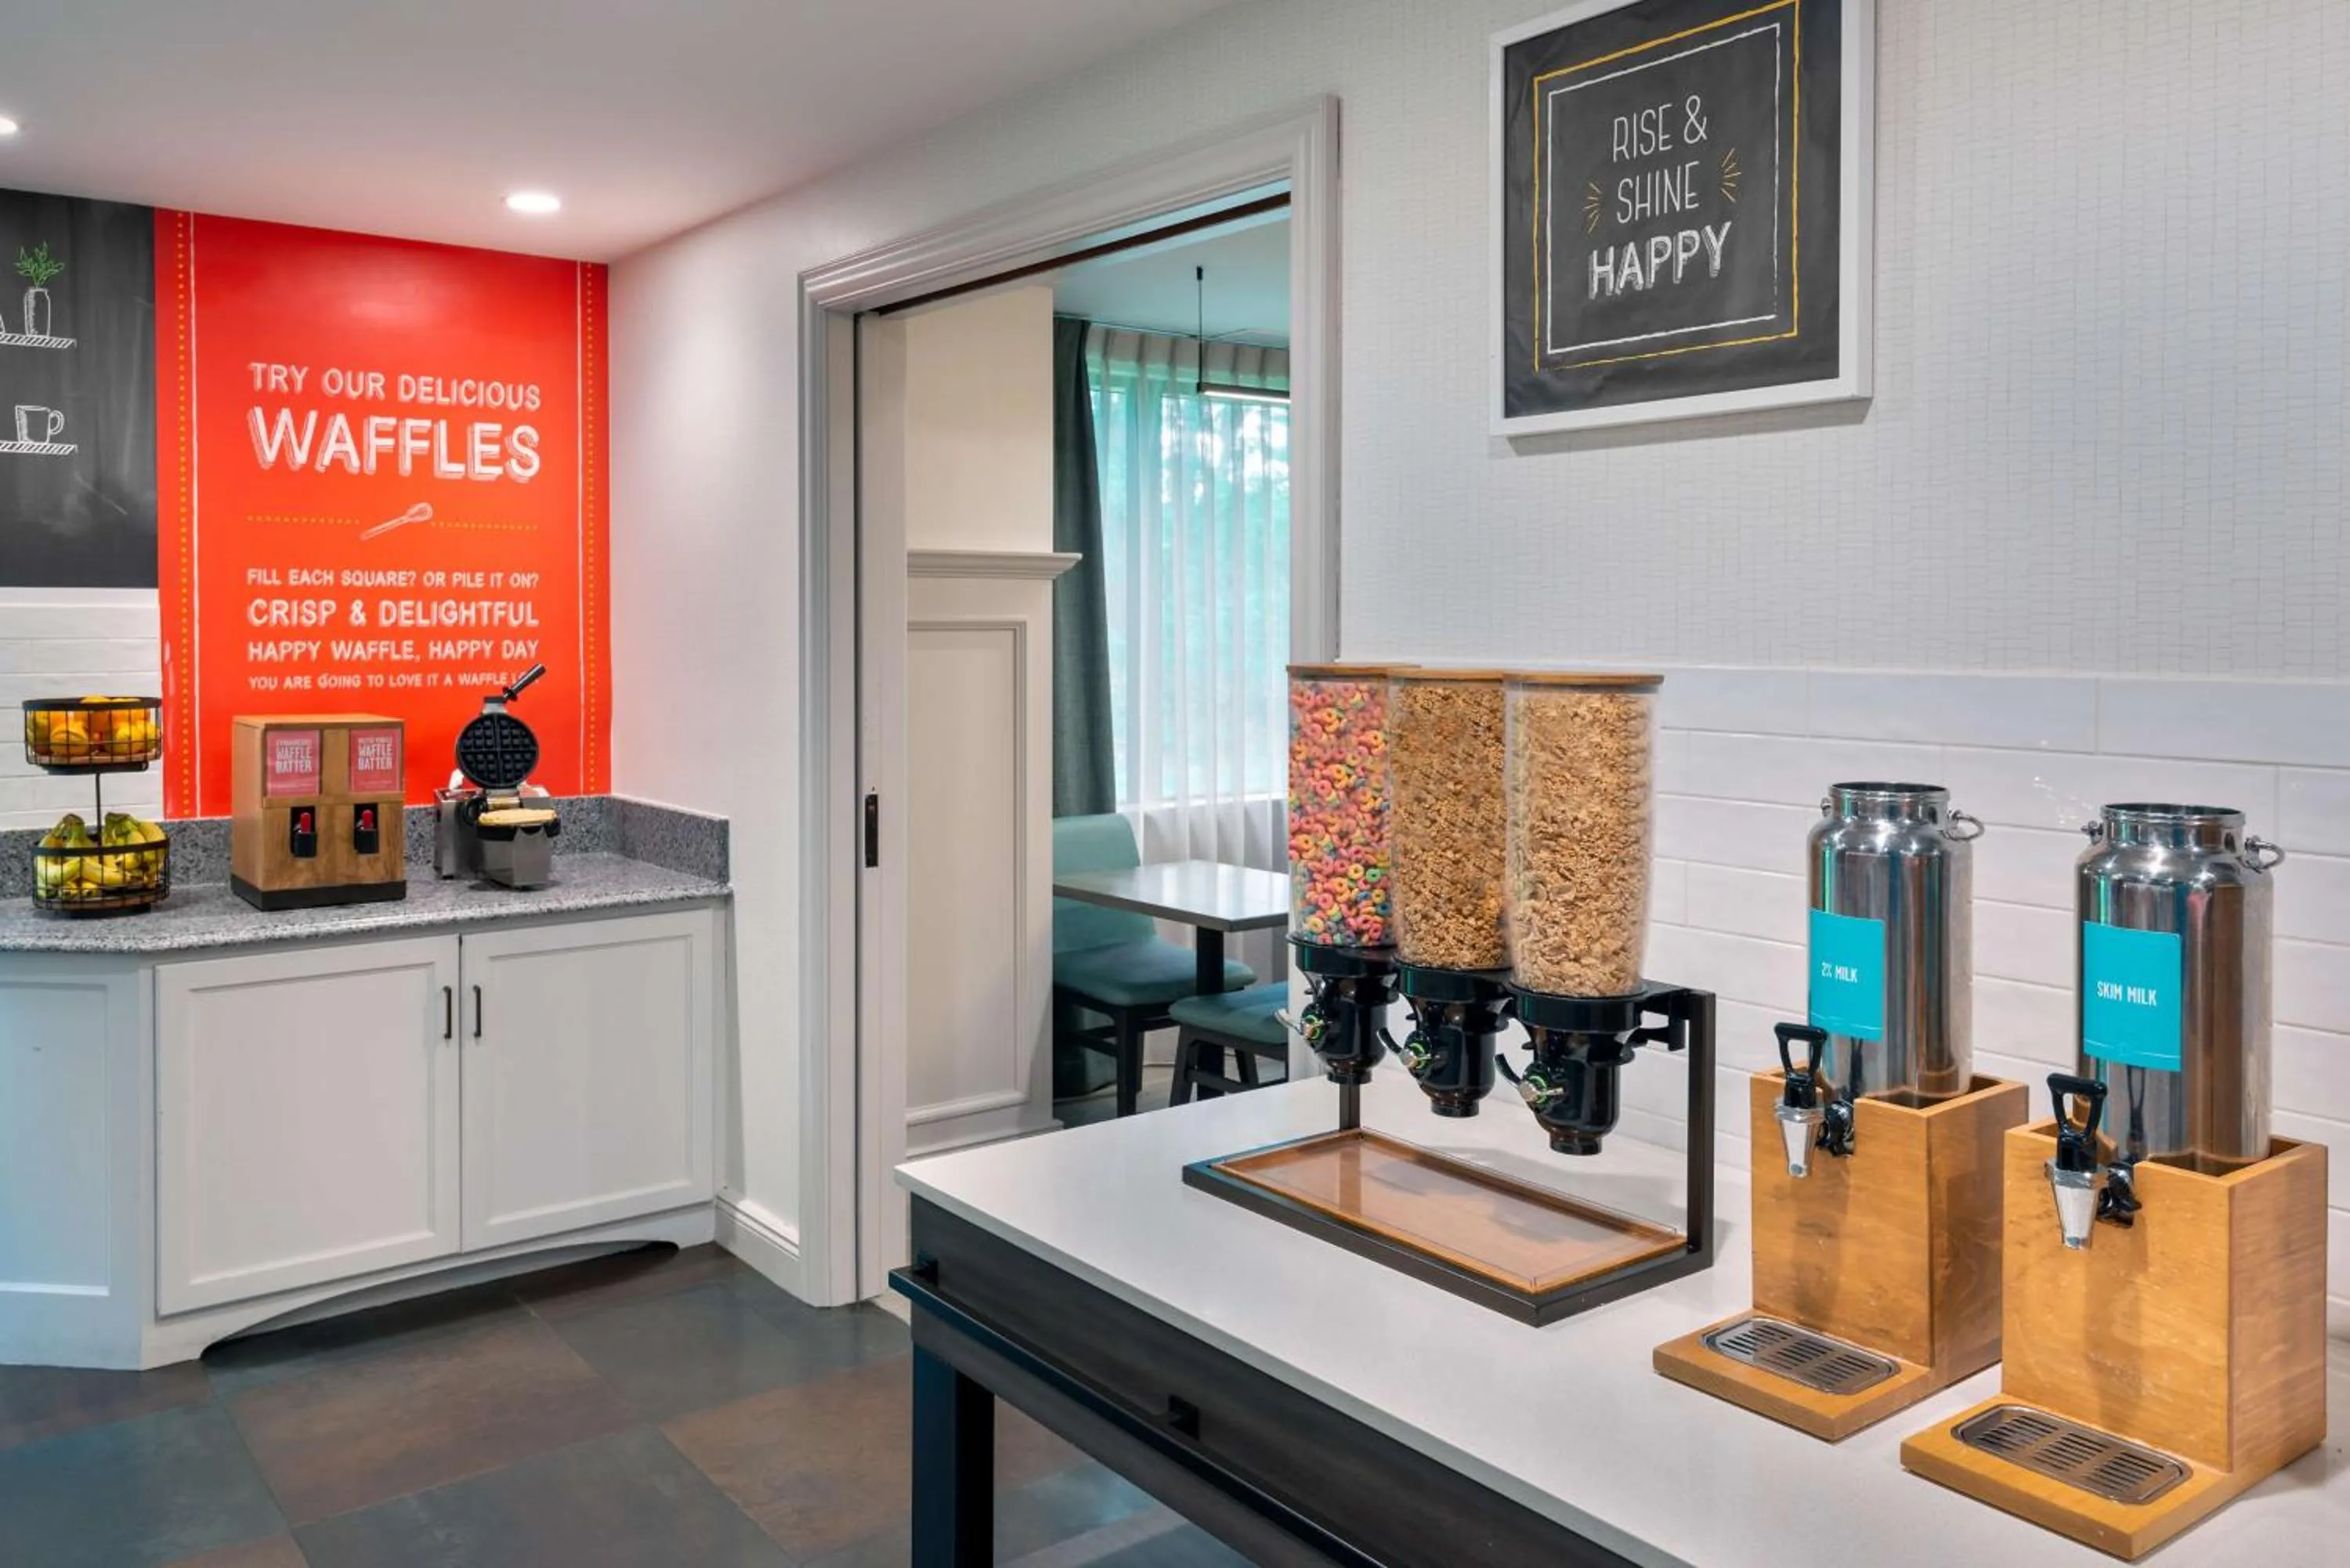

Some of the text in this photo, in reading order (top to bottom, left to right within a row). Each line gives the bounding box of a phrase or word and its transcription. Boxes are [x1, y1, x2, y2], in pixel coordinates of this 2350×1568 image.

[1612, 95, 1708, 163] RISE &
[1616, 161, 1700, 224] SHINE
[1588, 220, 1733, 300] HAPPY
[250, 363, 541, 412] TRY OUR DELICIOUS
[247, 406, 541, 484] WAFFLES
[247, 568, 540, 589] FILL EACH SQUARE? OR PILE IT ON?
[247, 598, 540, 627] CRISP & DELIGHTFUL
[248, 639, 540, 662] HAPPY WAFFLE, HAPPY DAY
[249, 676, 278, 690] YOU
[284, 675, 313, 690] ARE
[317, 674, 361, 689] GOING
[367, 674, 385, 688] TO
[389, 674, 421, 688] LOVE
[427, 673, 439, 687] IT
[443, 673, 452, 686] A
[457, 672, 508, 686] WAFFLE
[1821, 962, 1857, 983] 2% MILK
[2097, 981, 2157, 1006] SKIM MILK
